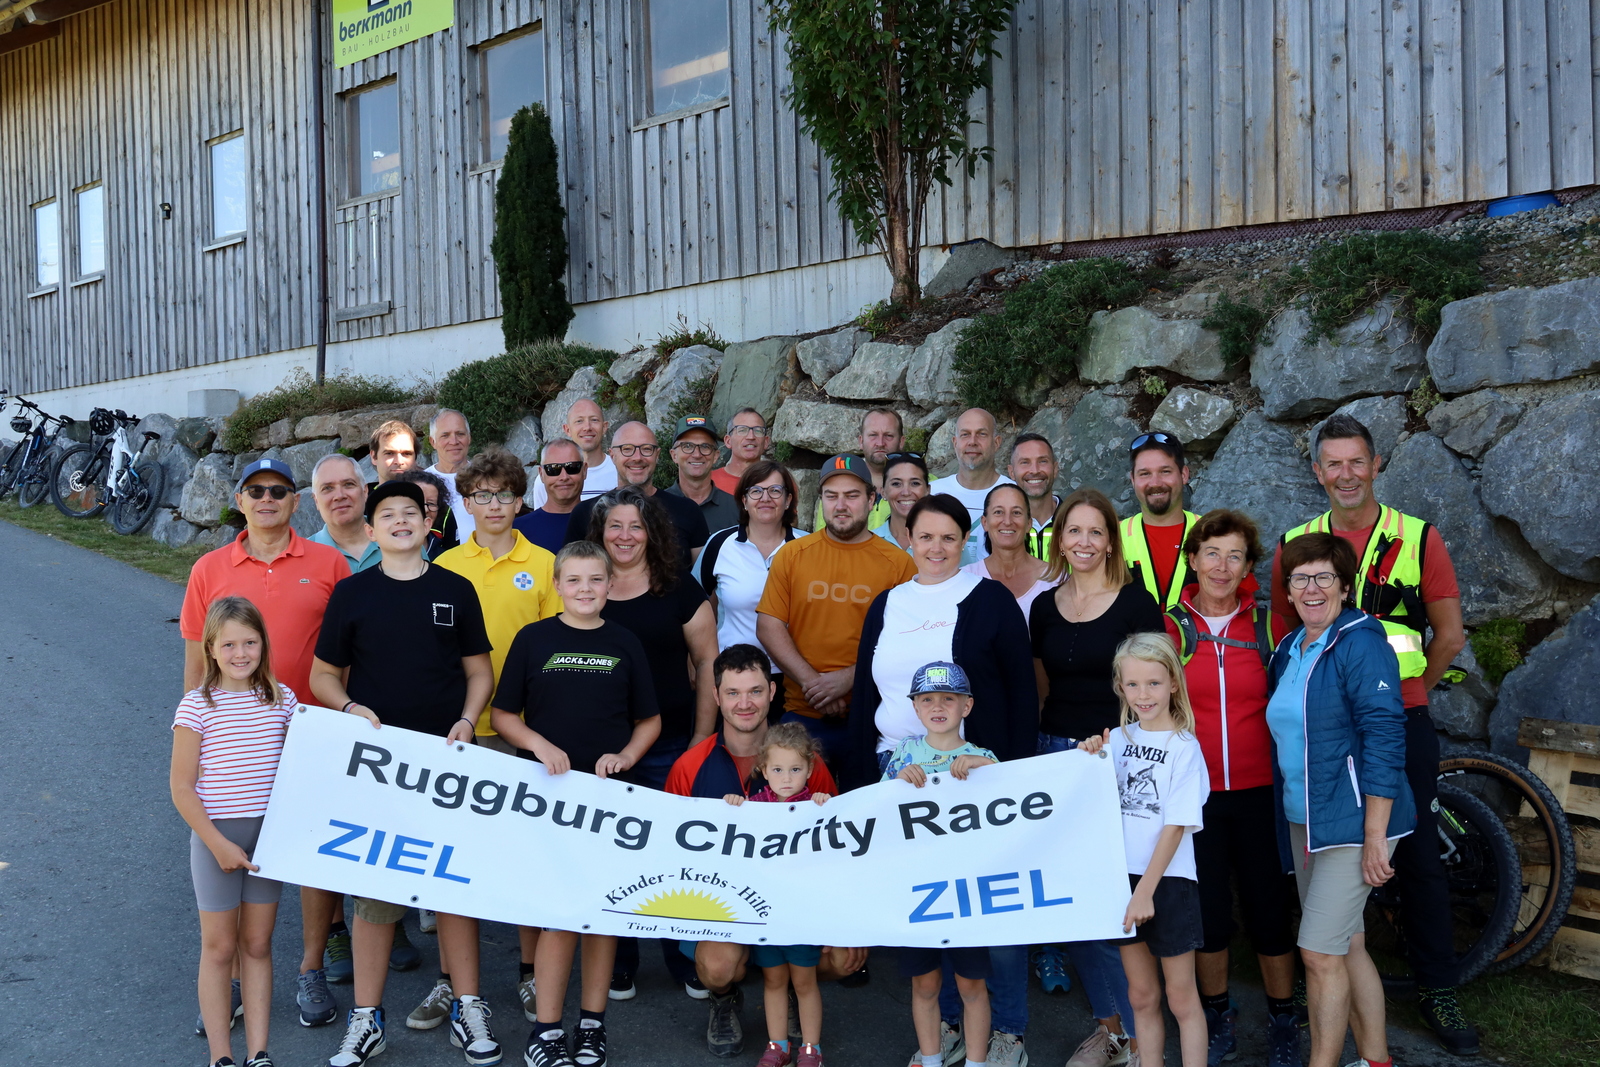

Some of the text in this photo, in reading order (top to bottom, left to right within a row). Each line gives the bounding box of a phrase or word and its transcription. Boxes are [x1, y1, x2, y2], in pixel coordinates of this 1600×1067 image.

[342, 44, 358, 57] BAU
[368, 23, 410, 44] HOLZBAU
[553, 656, 613, 667] JACK&JONES
[1122, 744, 1169, 764] BAMBI
[346, 740, 1054, 860] Ruggburg Charity Race
[317, 818, 471, 884] ZIEL
[604, 872, 665, 906] Kinder
[679, 867, 729, 889] Krebs
[737, 885, 772, 919] Hilfe
[908, 869, 1074, 924] ZIEL
[626, 921, 657, 932] Tirol
[670, 926, 733, 939] Vorarlberg
